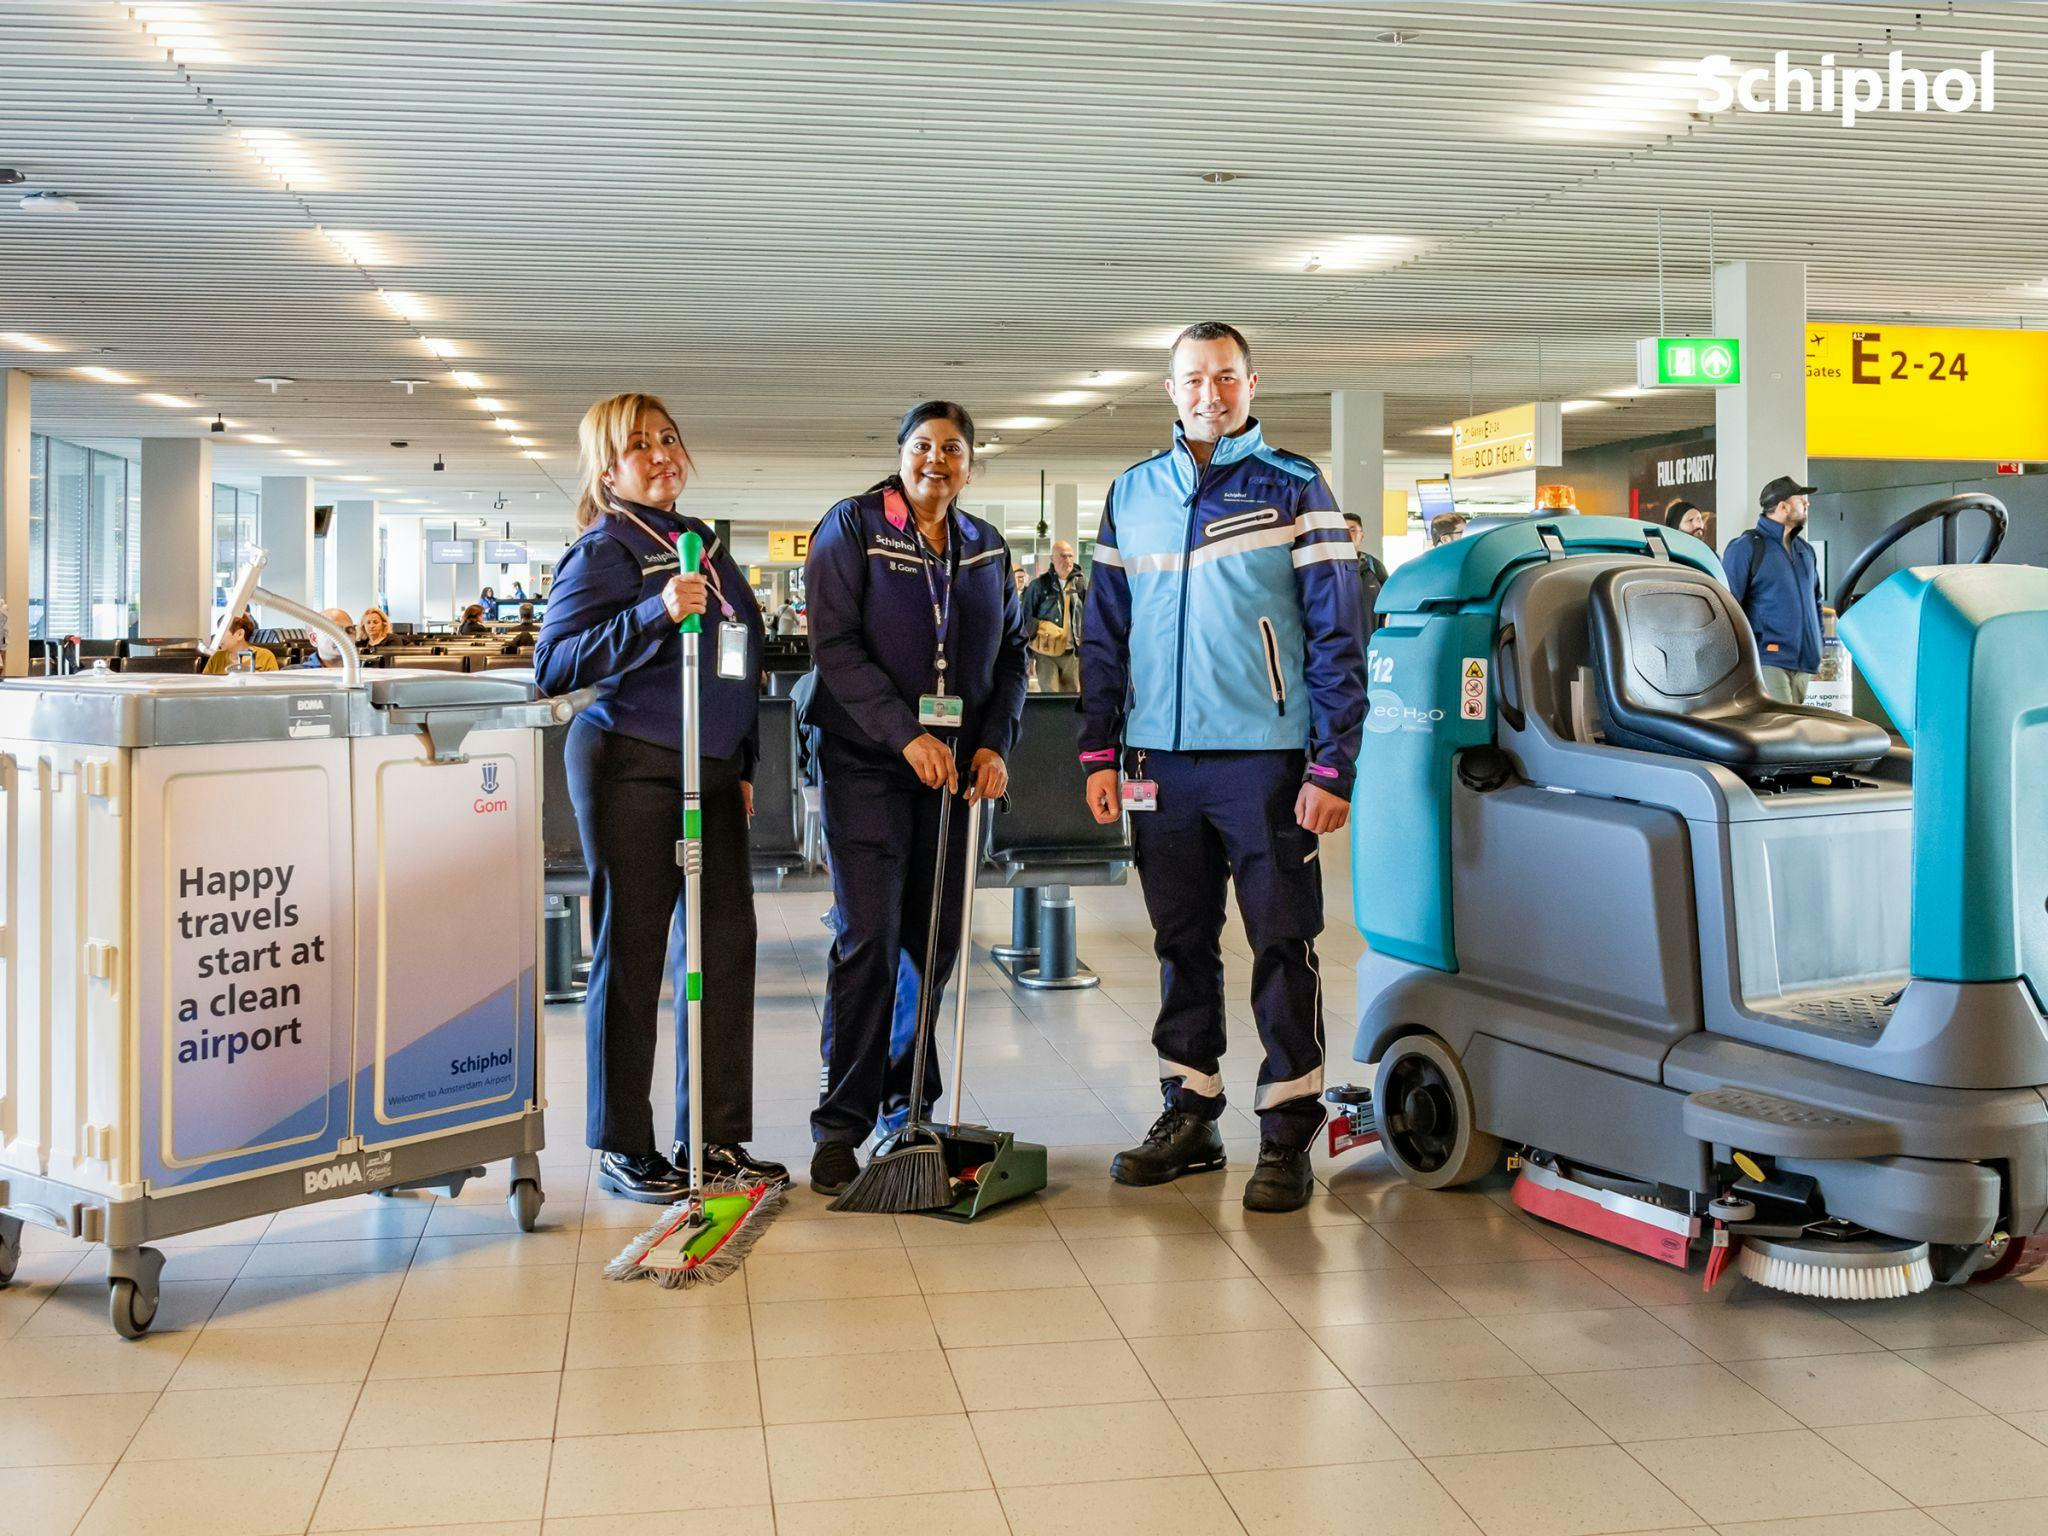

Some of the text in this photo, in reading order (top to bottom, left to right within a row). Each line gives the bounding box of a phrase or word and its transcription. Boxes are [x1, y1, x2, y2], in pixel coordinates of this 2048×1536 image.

[1853, 332, 1880, 384] E
[1891, 351, 1968, 381] 2-24
[1658, 454, 1714, 487] FULL OF PARTY
[794, 536, 806, 557] E
[875, 534, 916, 552] Schiphol
[897, 563, 918, 574] Gom
[297, 699, 324, 711] BOMA
[473, 798, 508, 814] Gom
[180, 864, 295, 902] Happy
[178, 897, 299, 940] travels
[198, 934, 325, 979] start at
[178, 983, 301, 1022] a clean
[178, 1017, 302, 1065] airport
[451, 1048, 512, 1076] Schiphol
[387, 1073, 511, 1106] Welcome to Amsterdam Airport
[304, 1161, 363, 1194] BOMA
